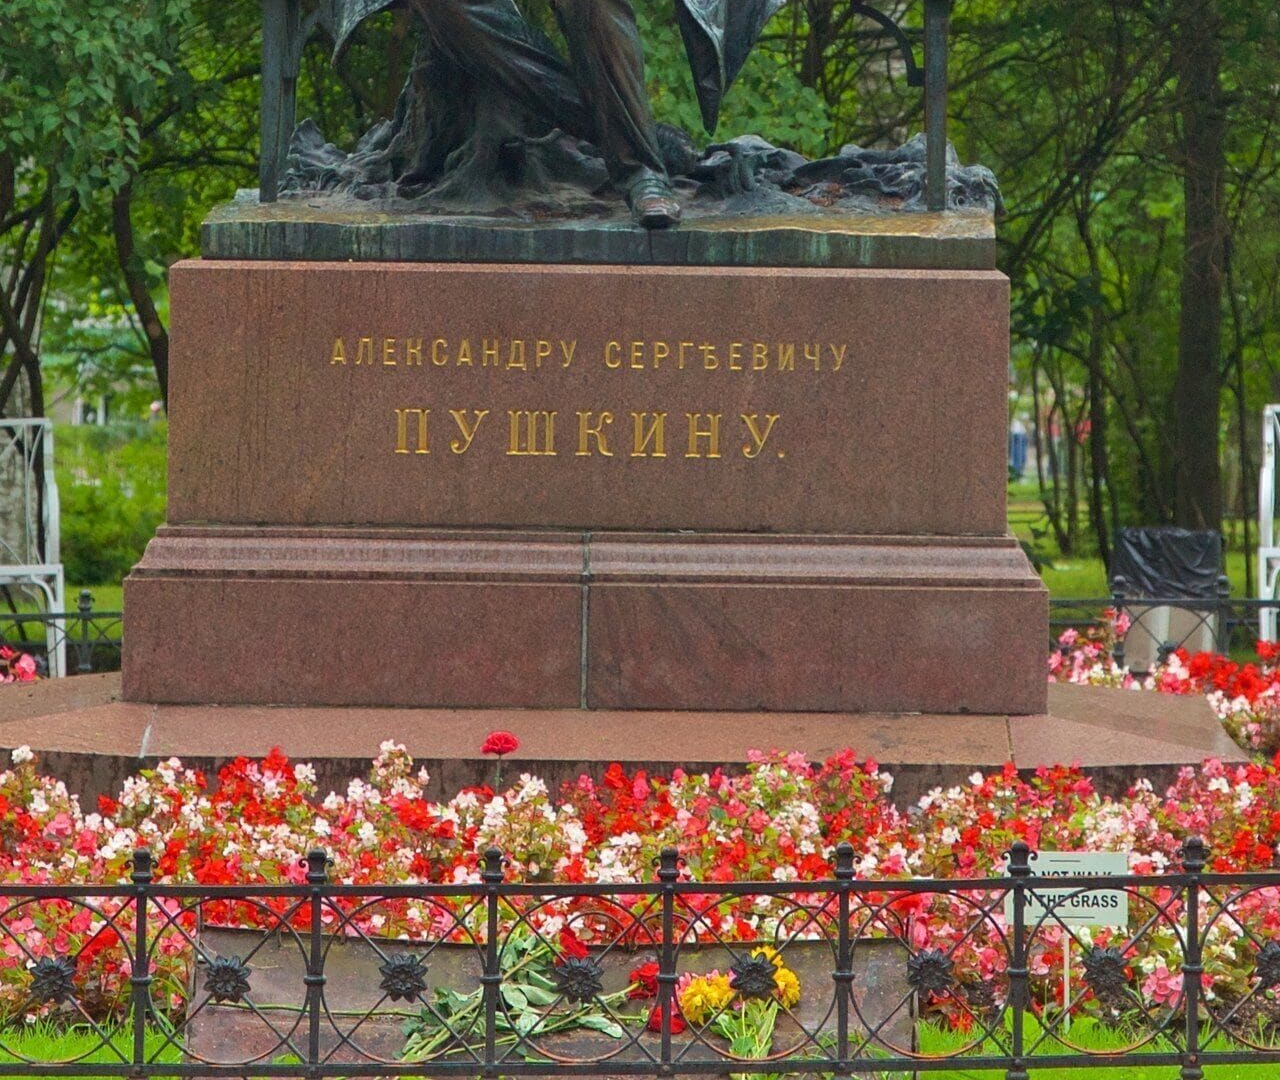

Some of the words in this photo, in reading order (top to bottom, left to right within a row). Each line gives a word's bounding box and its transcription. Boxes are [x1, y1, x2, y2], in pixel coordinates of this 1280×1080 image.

[329, 336, 577, 371] АЛЕКСАНДРУ
[393, 408, 787, 459] ПУШКИНУ.
[1070, 895, 1119, 908] GRASS
